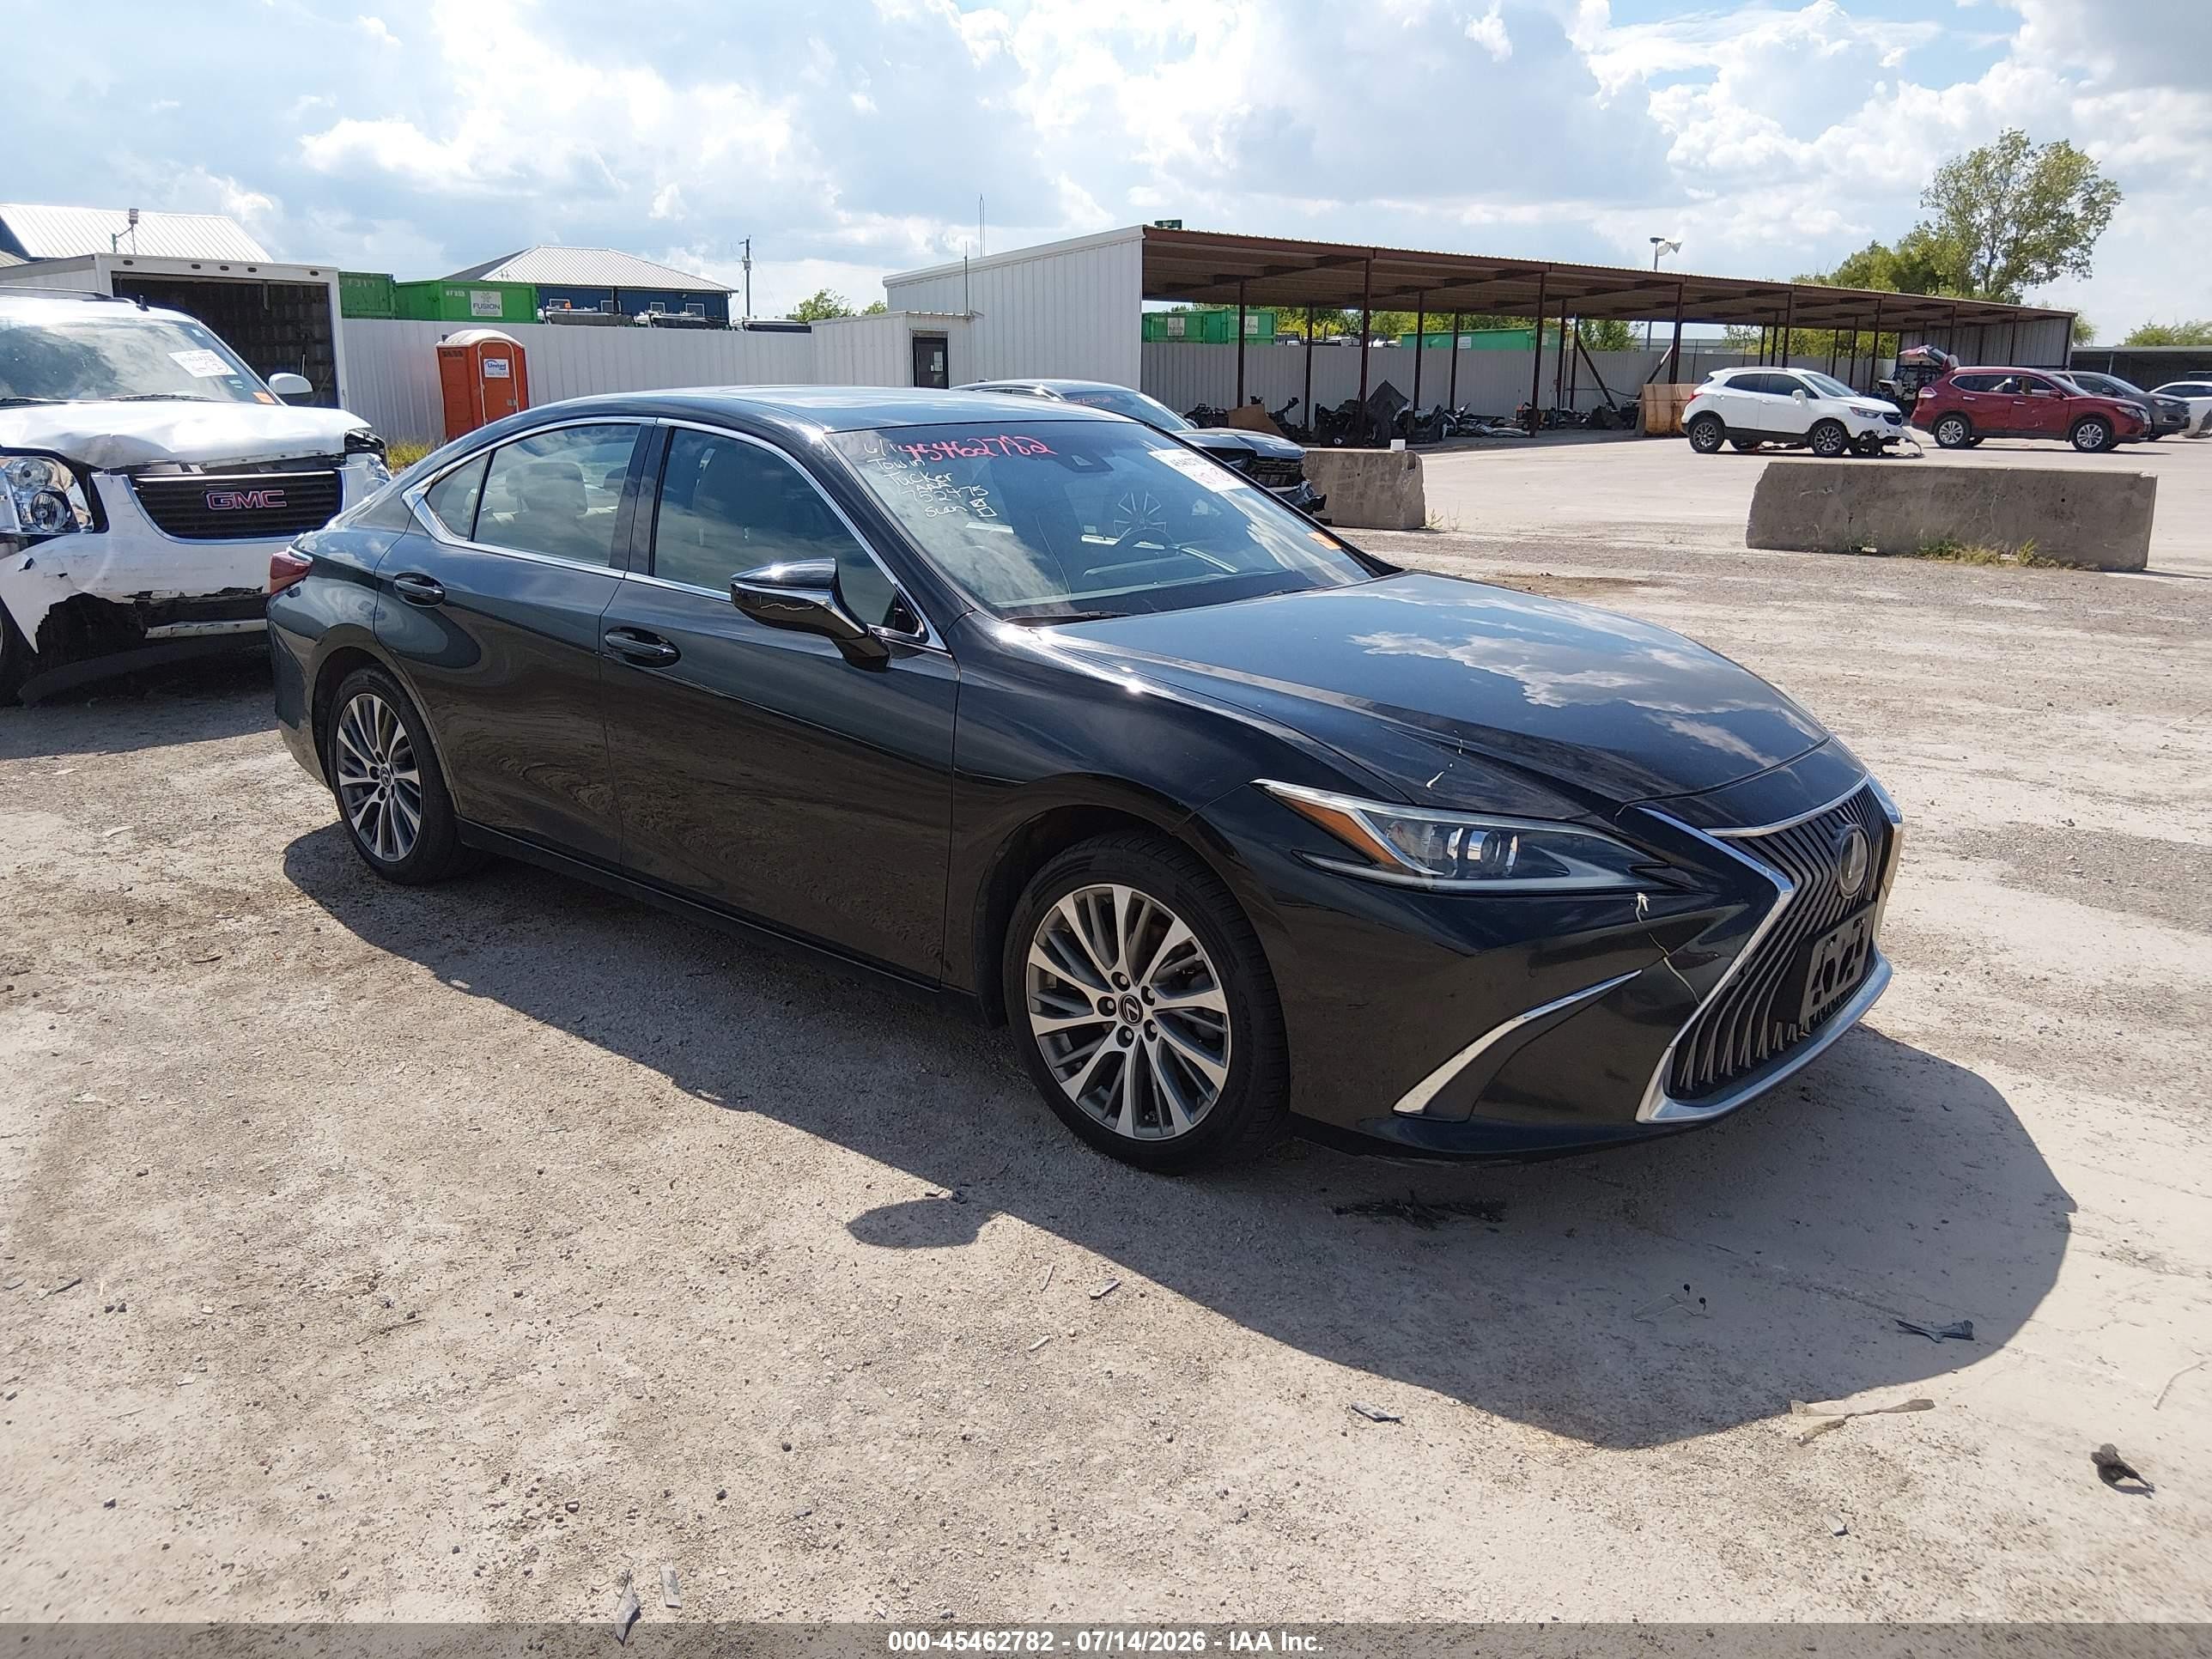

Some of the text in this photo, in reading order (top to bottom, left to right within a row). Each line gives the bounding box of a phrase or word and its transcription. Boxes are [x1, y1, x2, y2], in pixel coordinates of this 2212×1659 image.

[897, 435, 1059, 461] 45462782
[206, 489, 287, 510] GMC
[901, 484, 989, 502] 752475
